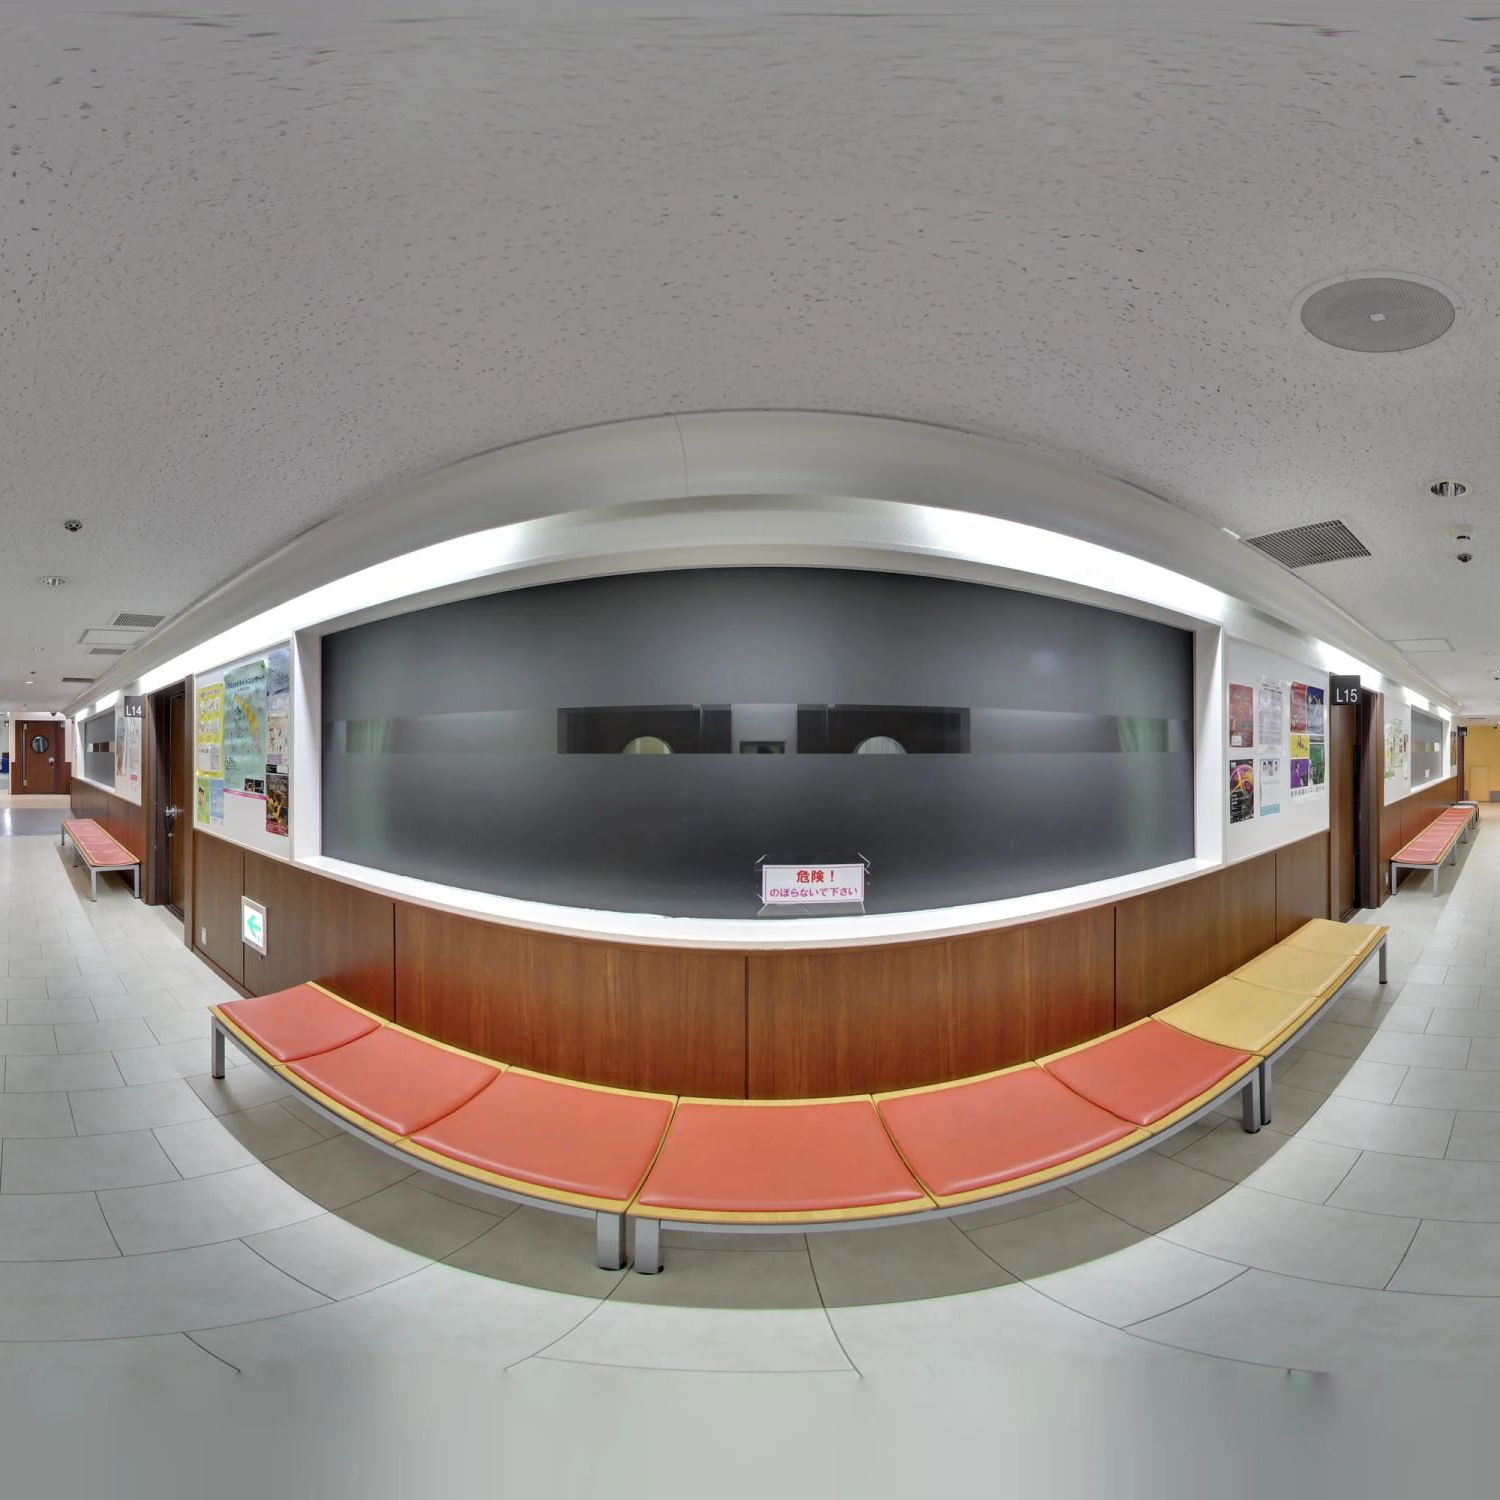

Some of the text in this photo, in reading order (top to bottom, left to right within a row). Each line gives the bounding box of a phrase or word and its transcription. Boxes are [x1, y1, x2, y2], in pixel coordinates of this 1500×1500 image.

[1336, 687, 1358, 703] L15
[126, 705, 141, 716] L14
[769, 887, 858, 897] のぼらないで下さい
